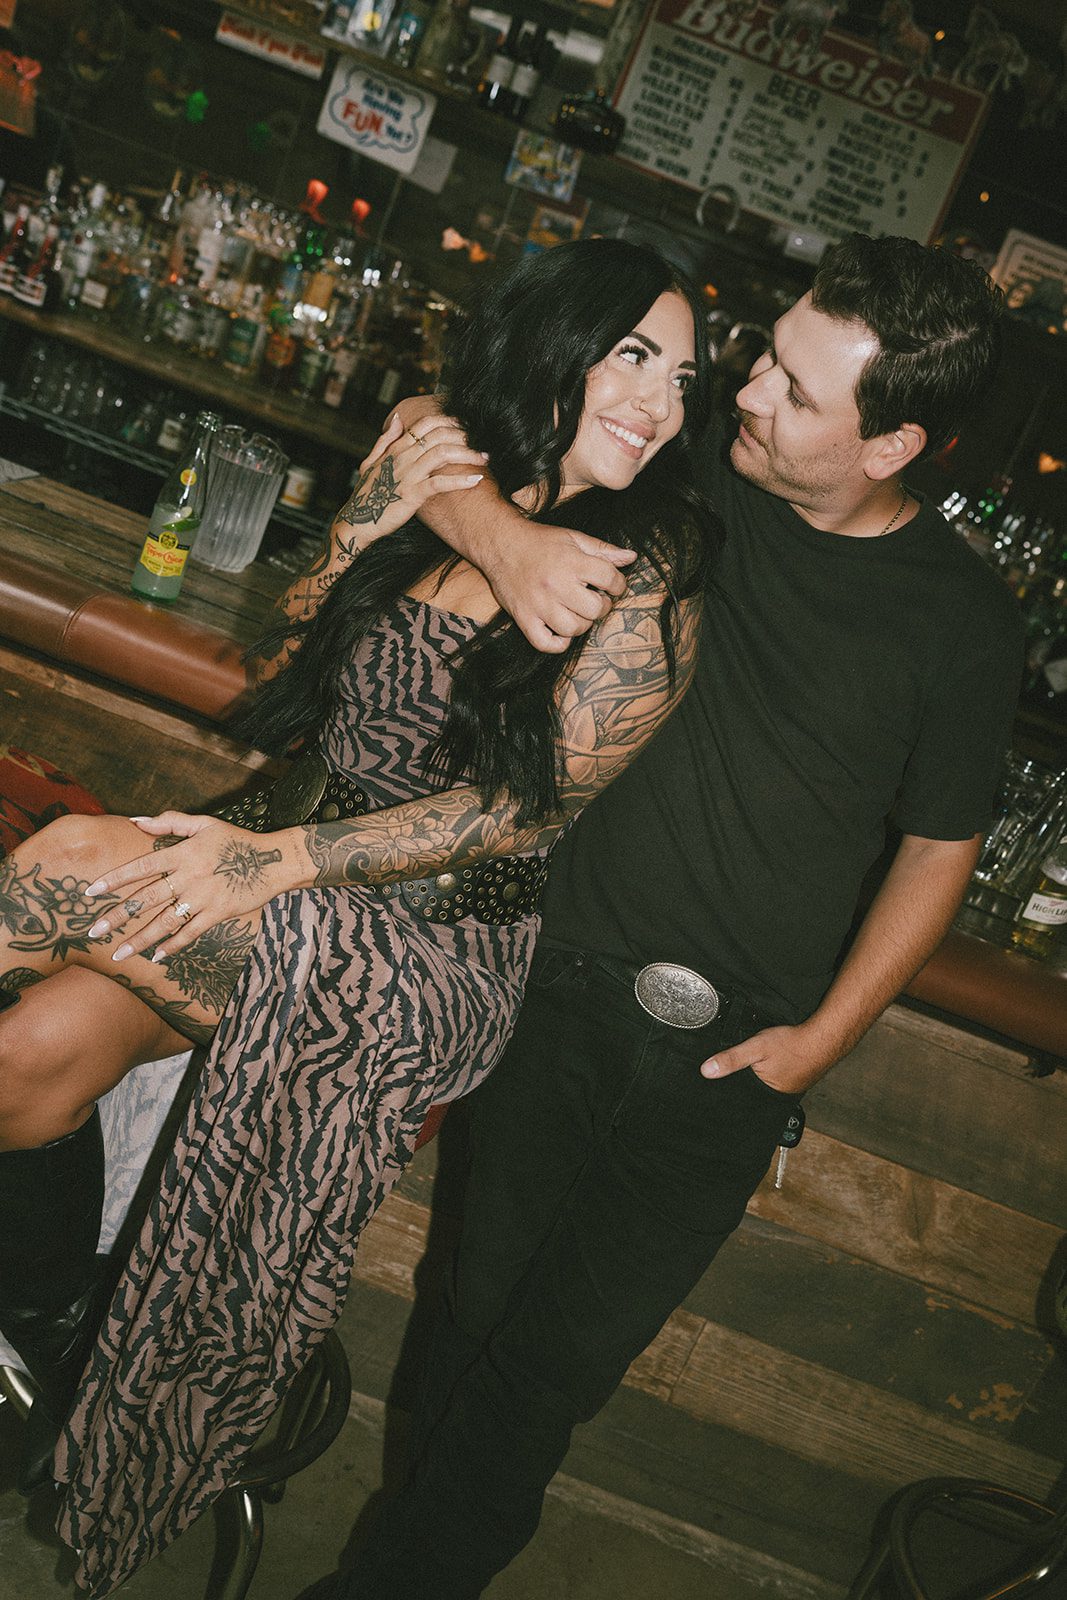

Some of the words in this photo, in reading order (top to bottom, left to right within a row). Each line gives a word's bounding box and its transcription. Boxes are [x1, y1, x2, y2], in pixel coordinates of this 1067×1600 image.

[675, 0, 954, 127] Budweiser
[767, 74, 821, 110] BEER
[341, 100, 384, 138] FUN
[1032, 902, 1055, 914] HIGH
